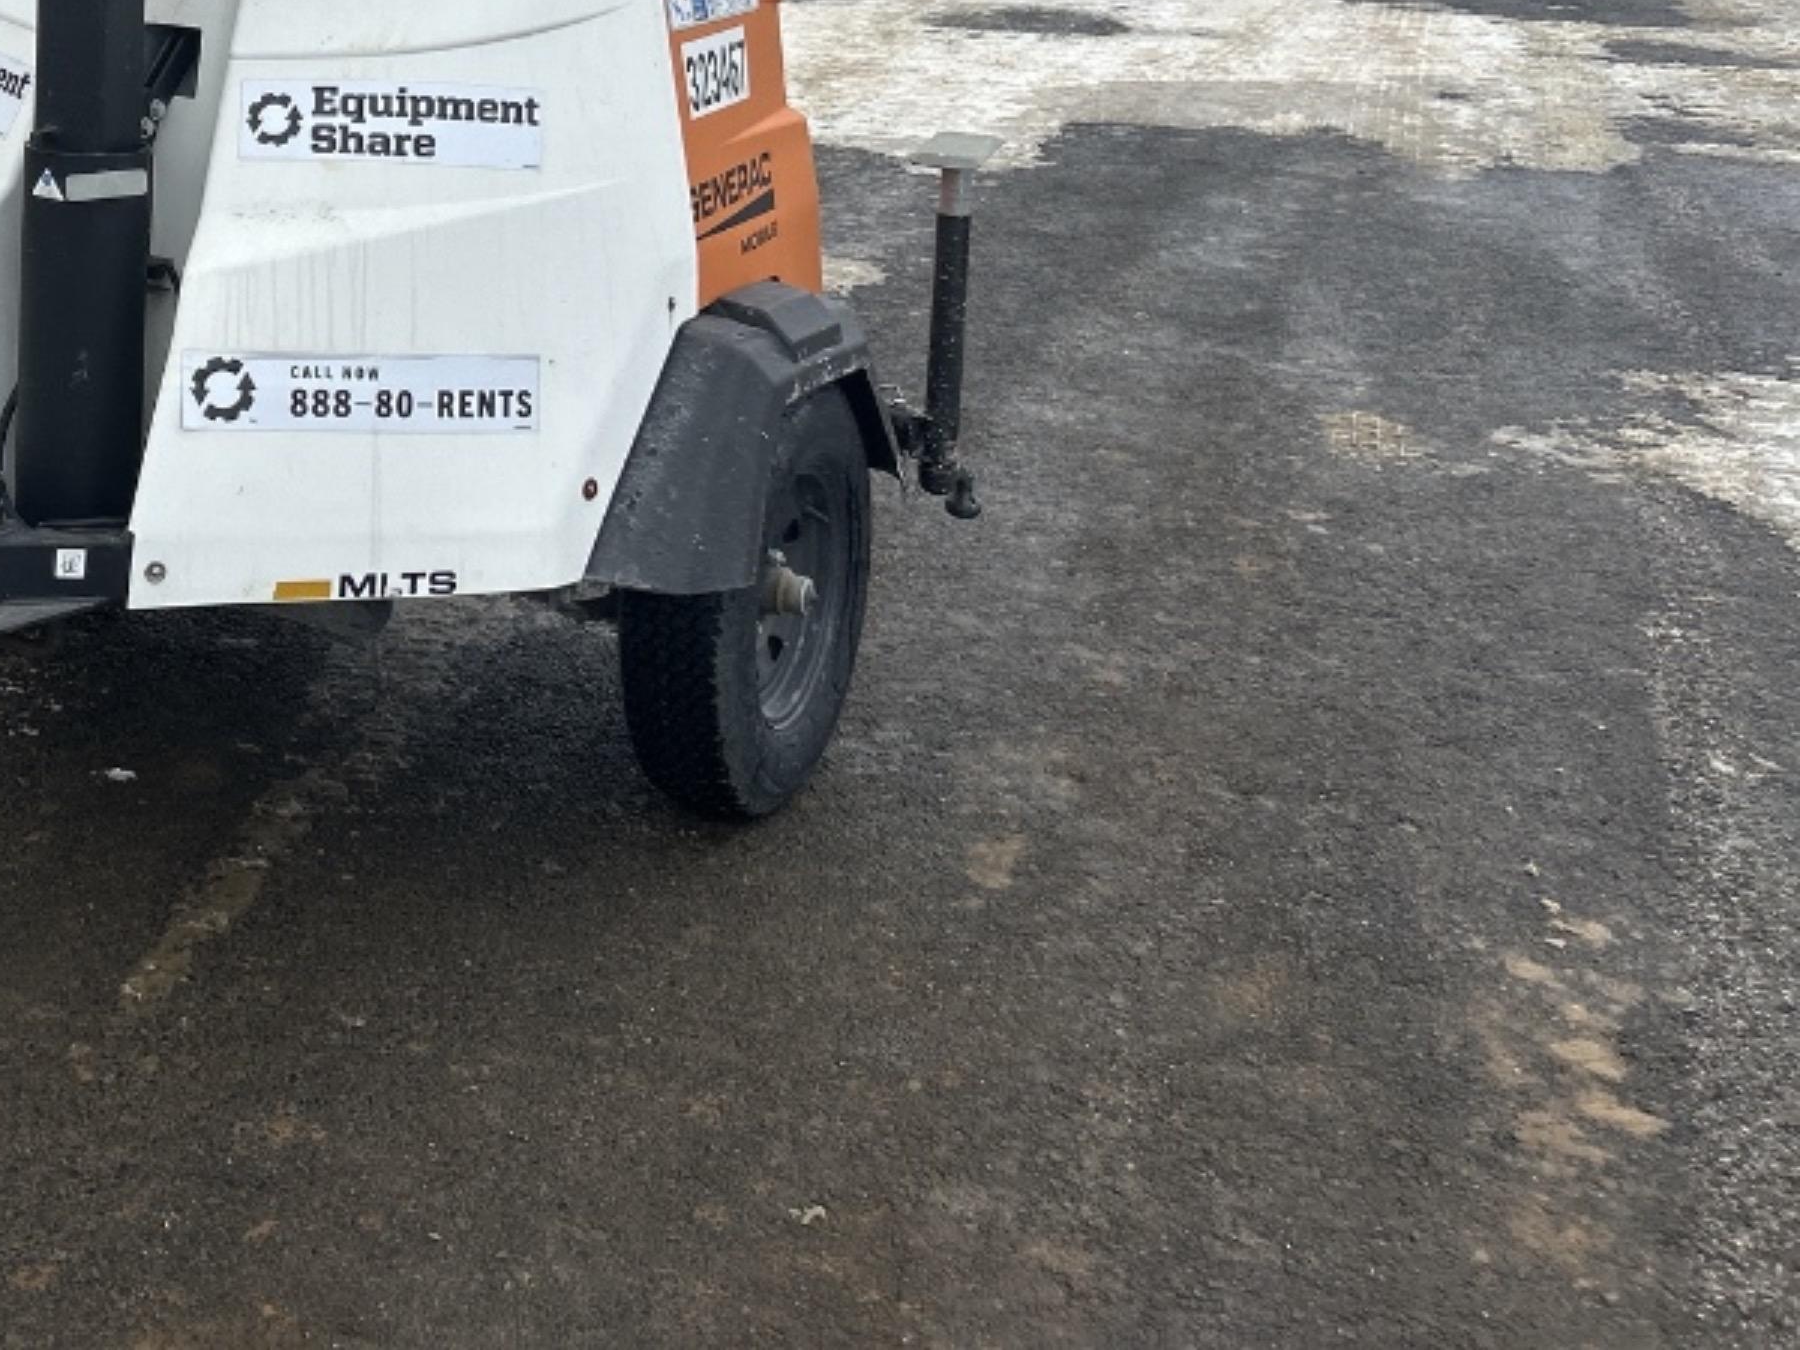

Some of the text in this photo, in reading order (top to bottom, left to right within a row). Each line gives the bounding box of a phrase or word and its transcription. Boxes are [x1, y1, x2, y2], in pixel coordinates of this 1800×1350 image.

[311, 85, 541, 127] Equipment
[310, 123, 437, 157] Share
[290, 365, 379, 382] CALL NOW
[290, 388, 533, 419] 888-80-RENTS
